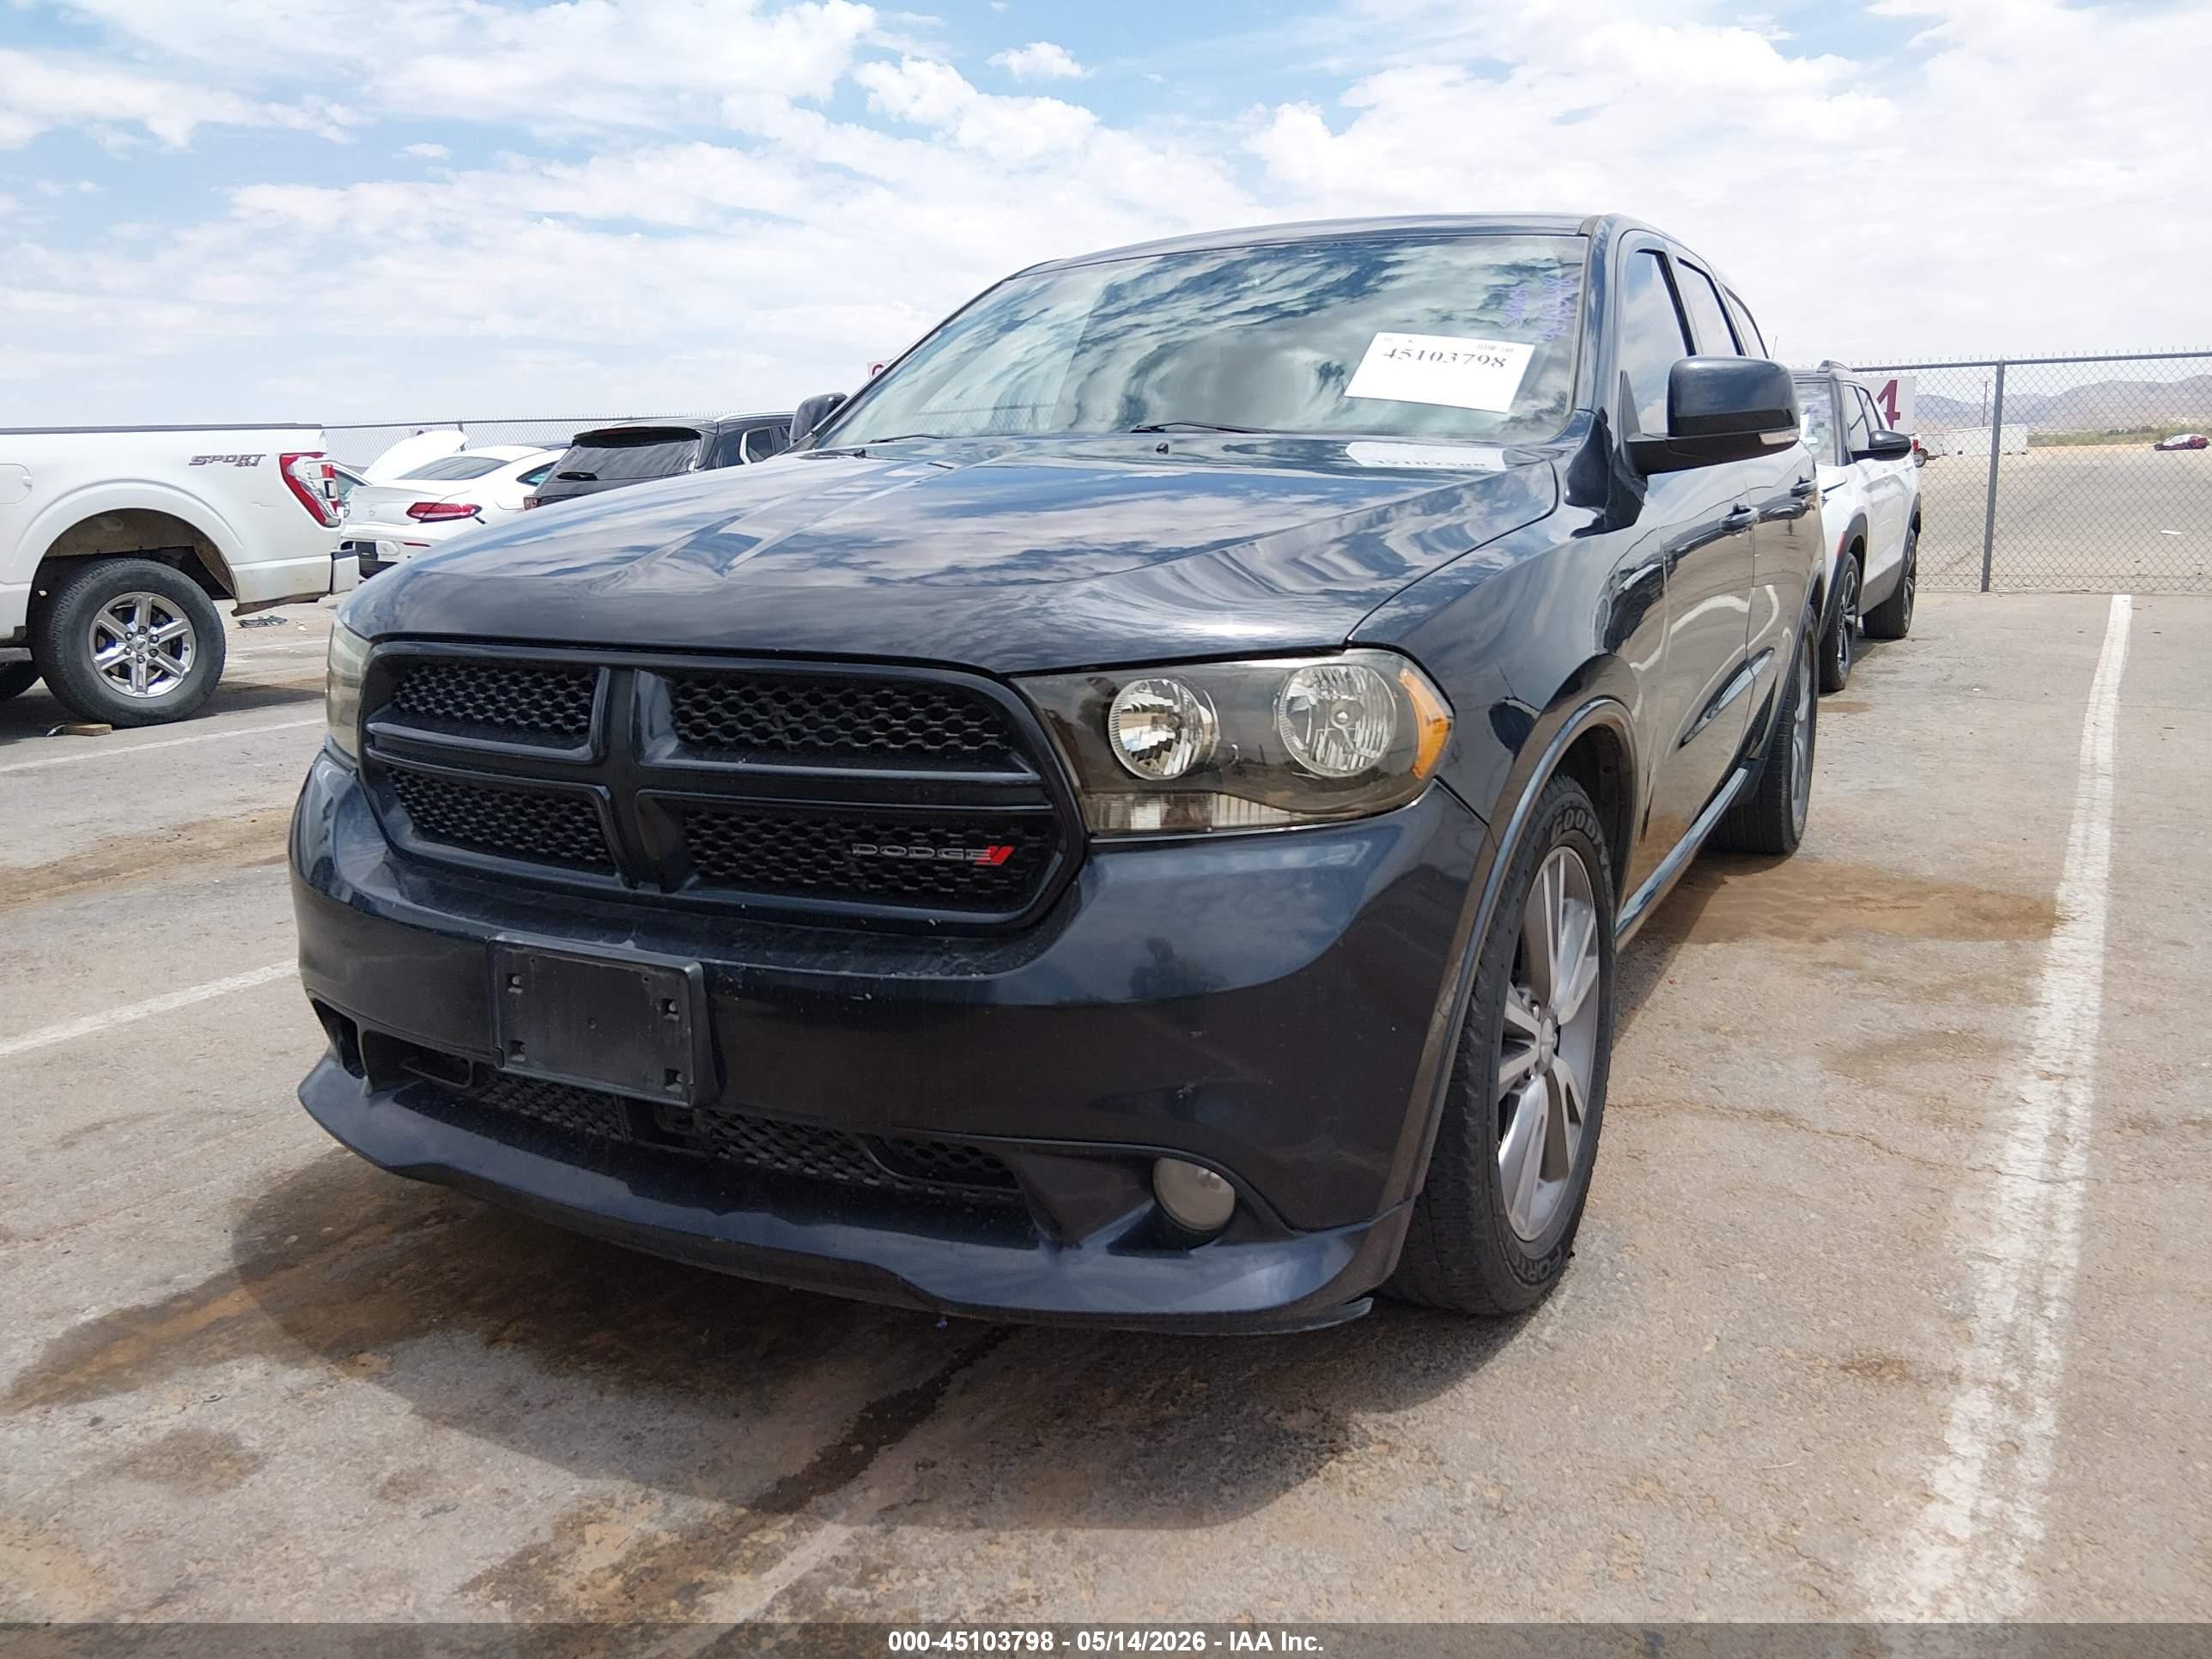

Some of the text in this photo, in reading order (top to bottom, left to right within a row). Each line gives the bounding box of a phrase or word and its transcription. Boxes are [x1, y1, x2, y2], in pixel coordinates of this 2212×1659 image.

[1383, 349, 1507, 368] 45103798
[1876, 379, 1901, 430] 4
[188, 454, 267, 465] SPORT
[852, 843, 992, 860] DODGE
